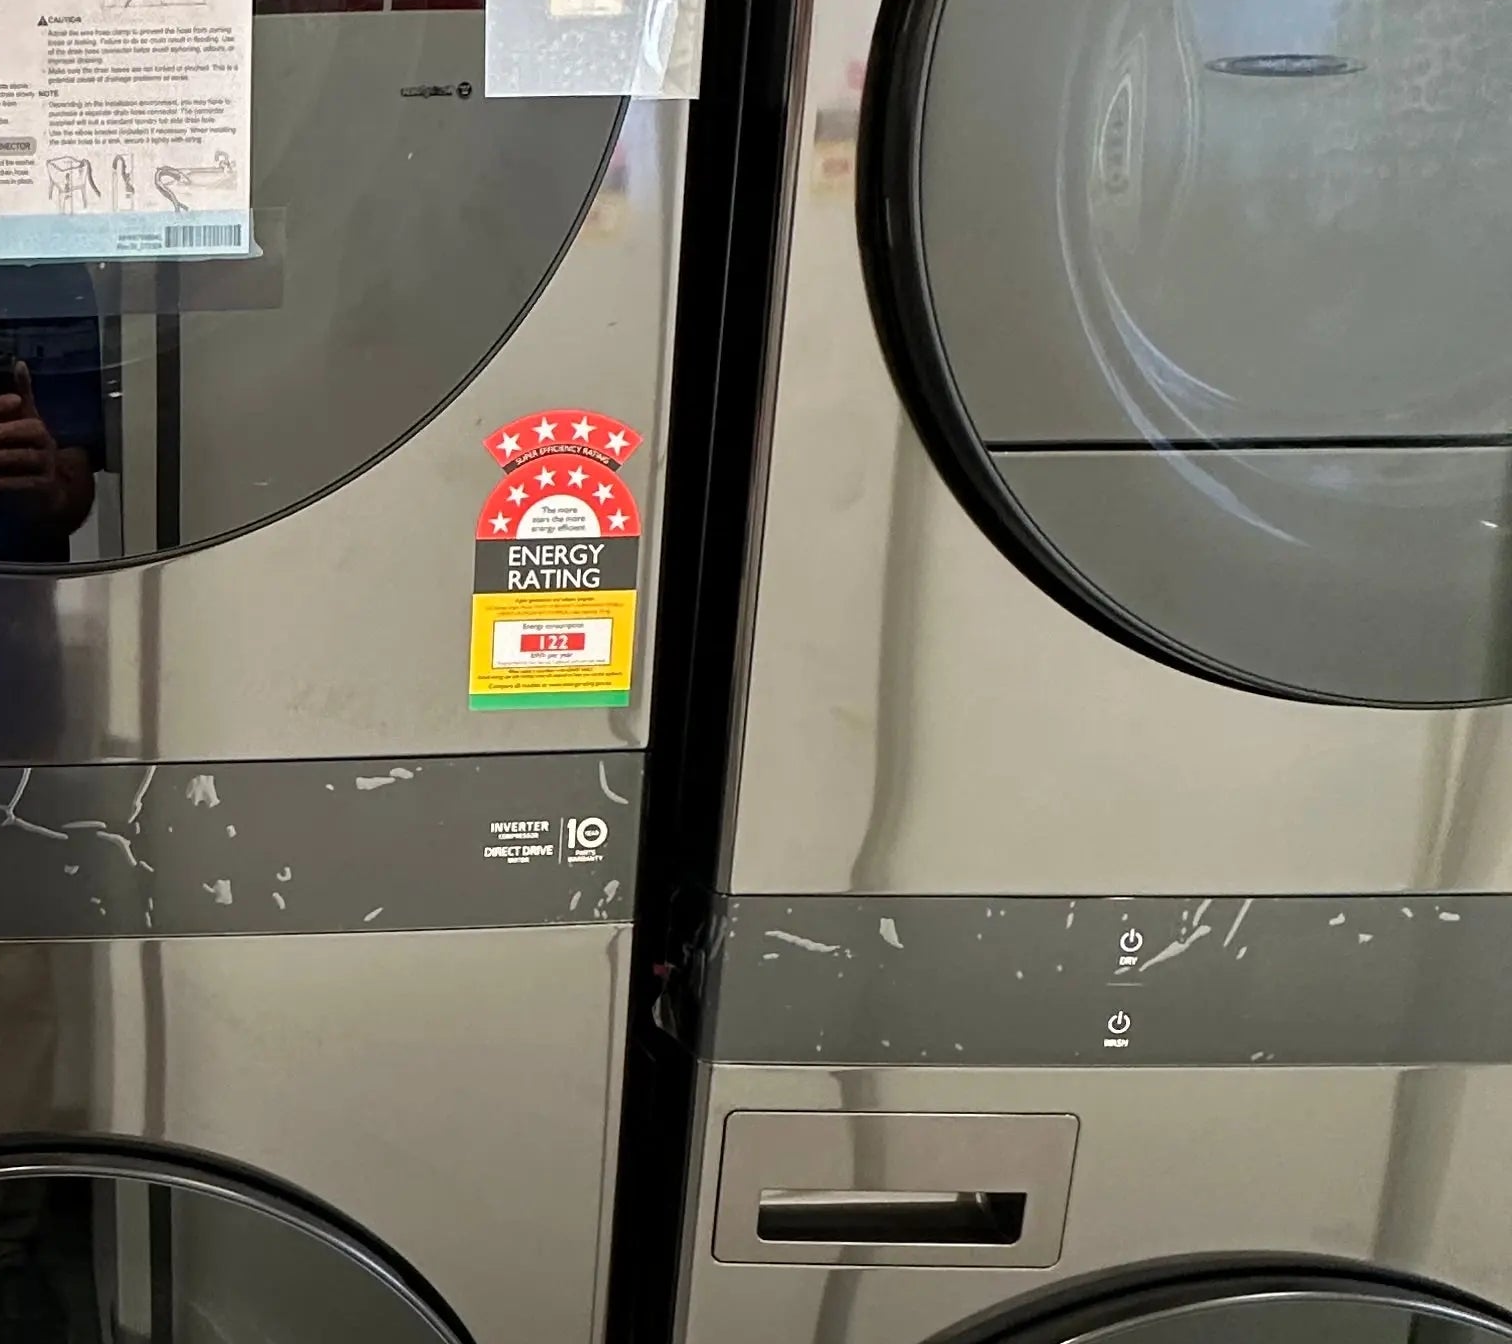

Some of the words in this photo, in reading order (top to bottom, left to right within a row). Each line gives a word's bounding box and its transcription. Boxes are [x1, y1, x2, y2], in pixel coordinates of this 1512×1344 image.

[38, 89, 59, 97] NOTE
[508, 543, 605, 567] ENERGY
[507, 567, 601, 590] RATING
[539, 634, 569, 650] 122
[490, 820, 550, 833] INVERTER
[566, 816, 609, 849] 10
[484, 846, 522, 858] DIRECT
[522, 844, 554, 857] DRIVE
[1119, 955, 1138, 966] DRY
